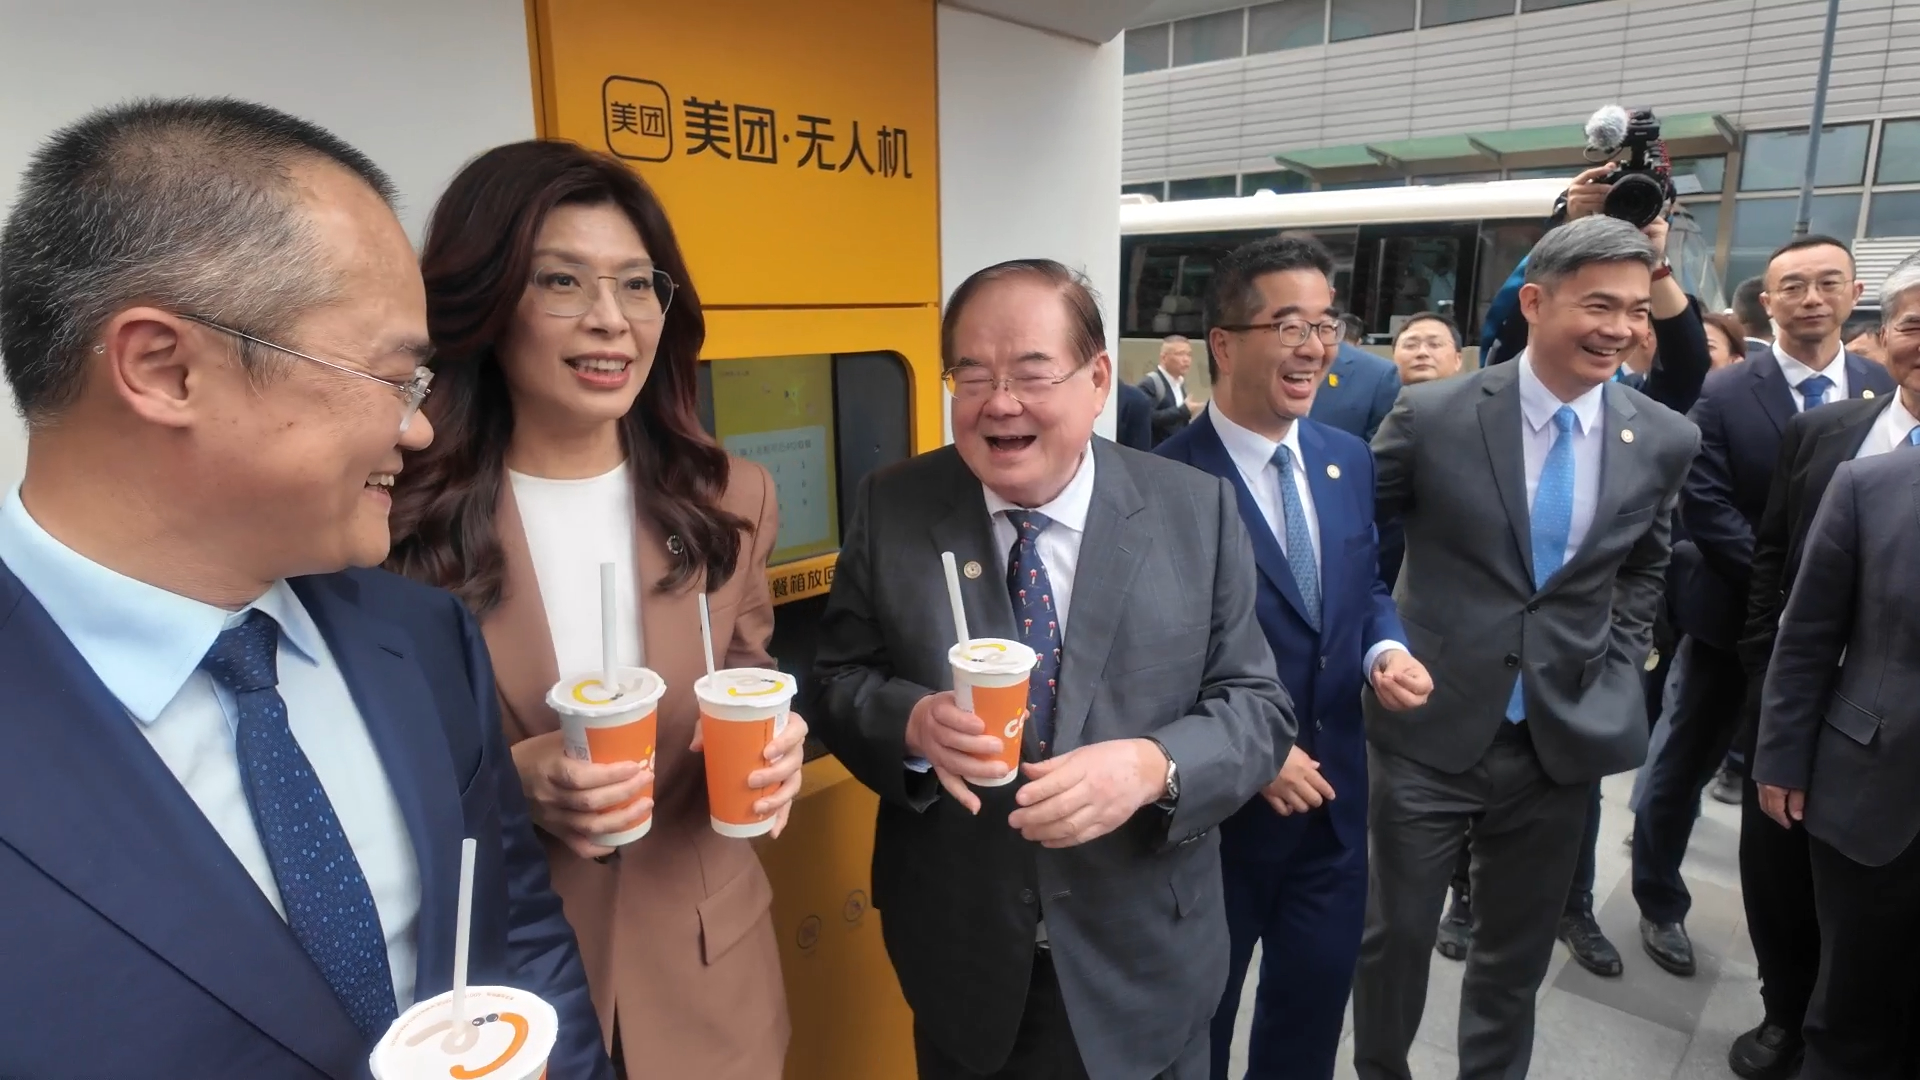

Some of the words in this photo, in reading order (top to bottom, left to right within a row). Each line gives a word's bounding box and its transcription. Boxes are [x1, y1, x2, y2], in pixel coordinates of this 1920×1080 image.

[611, 102, 665, 137] 美团
[683, 96, 912, 178] 美团·无人机
[768, 566, 836, 598] 餐箱放回
